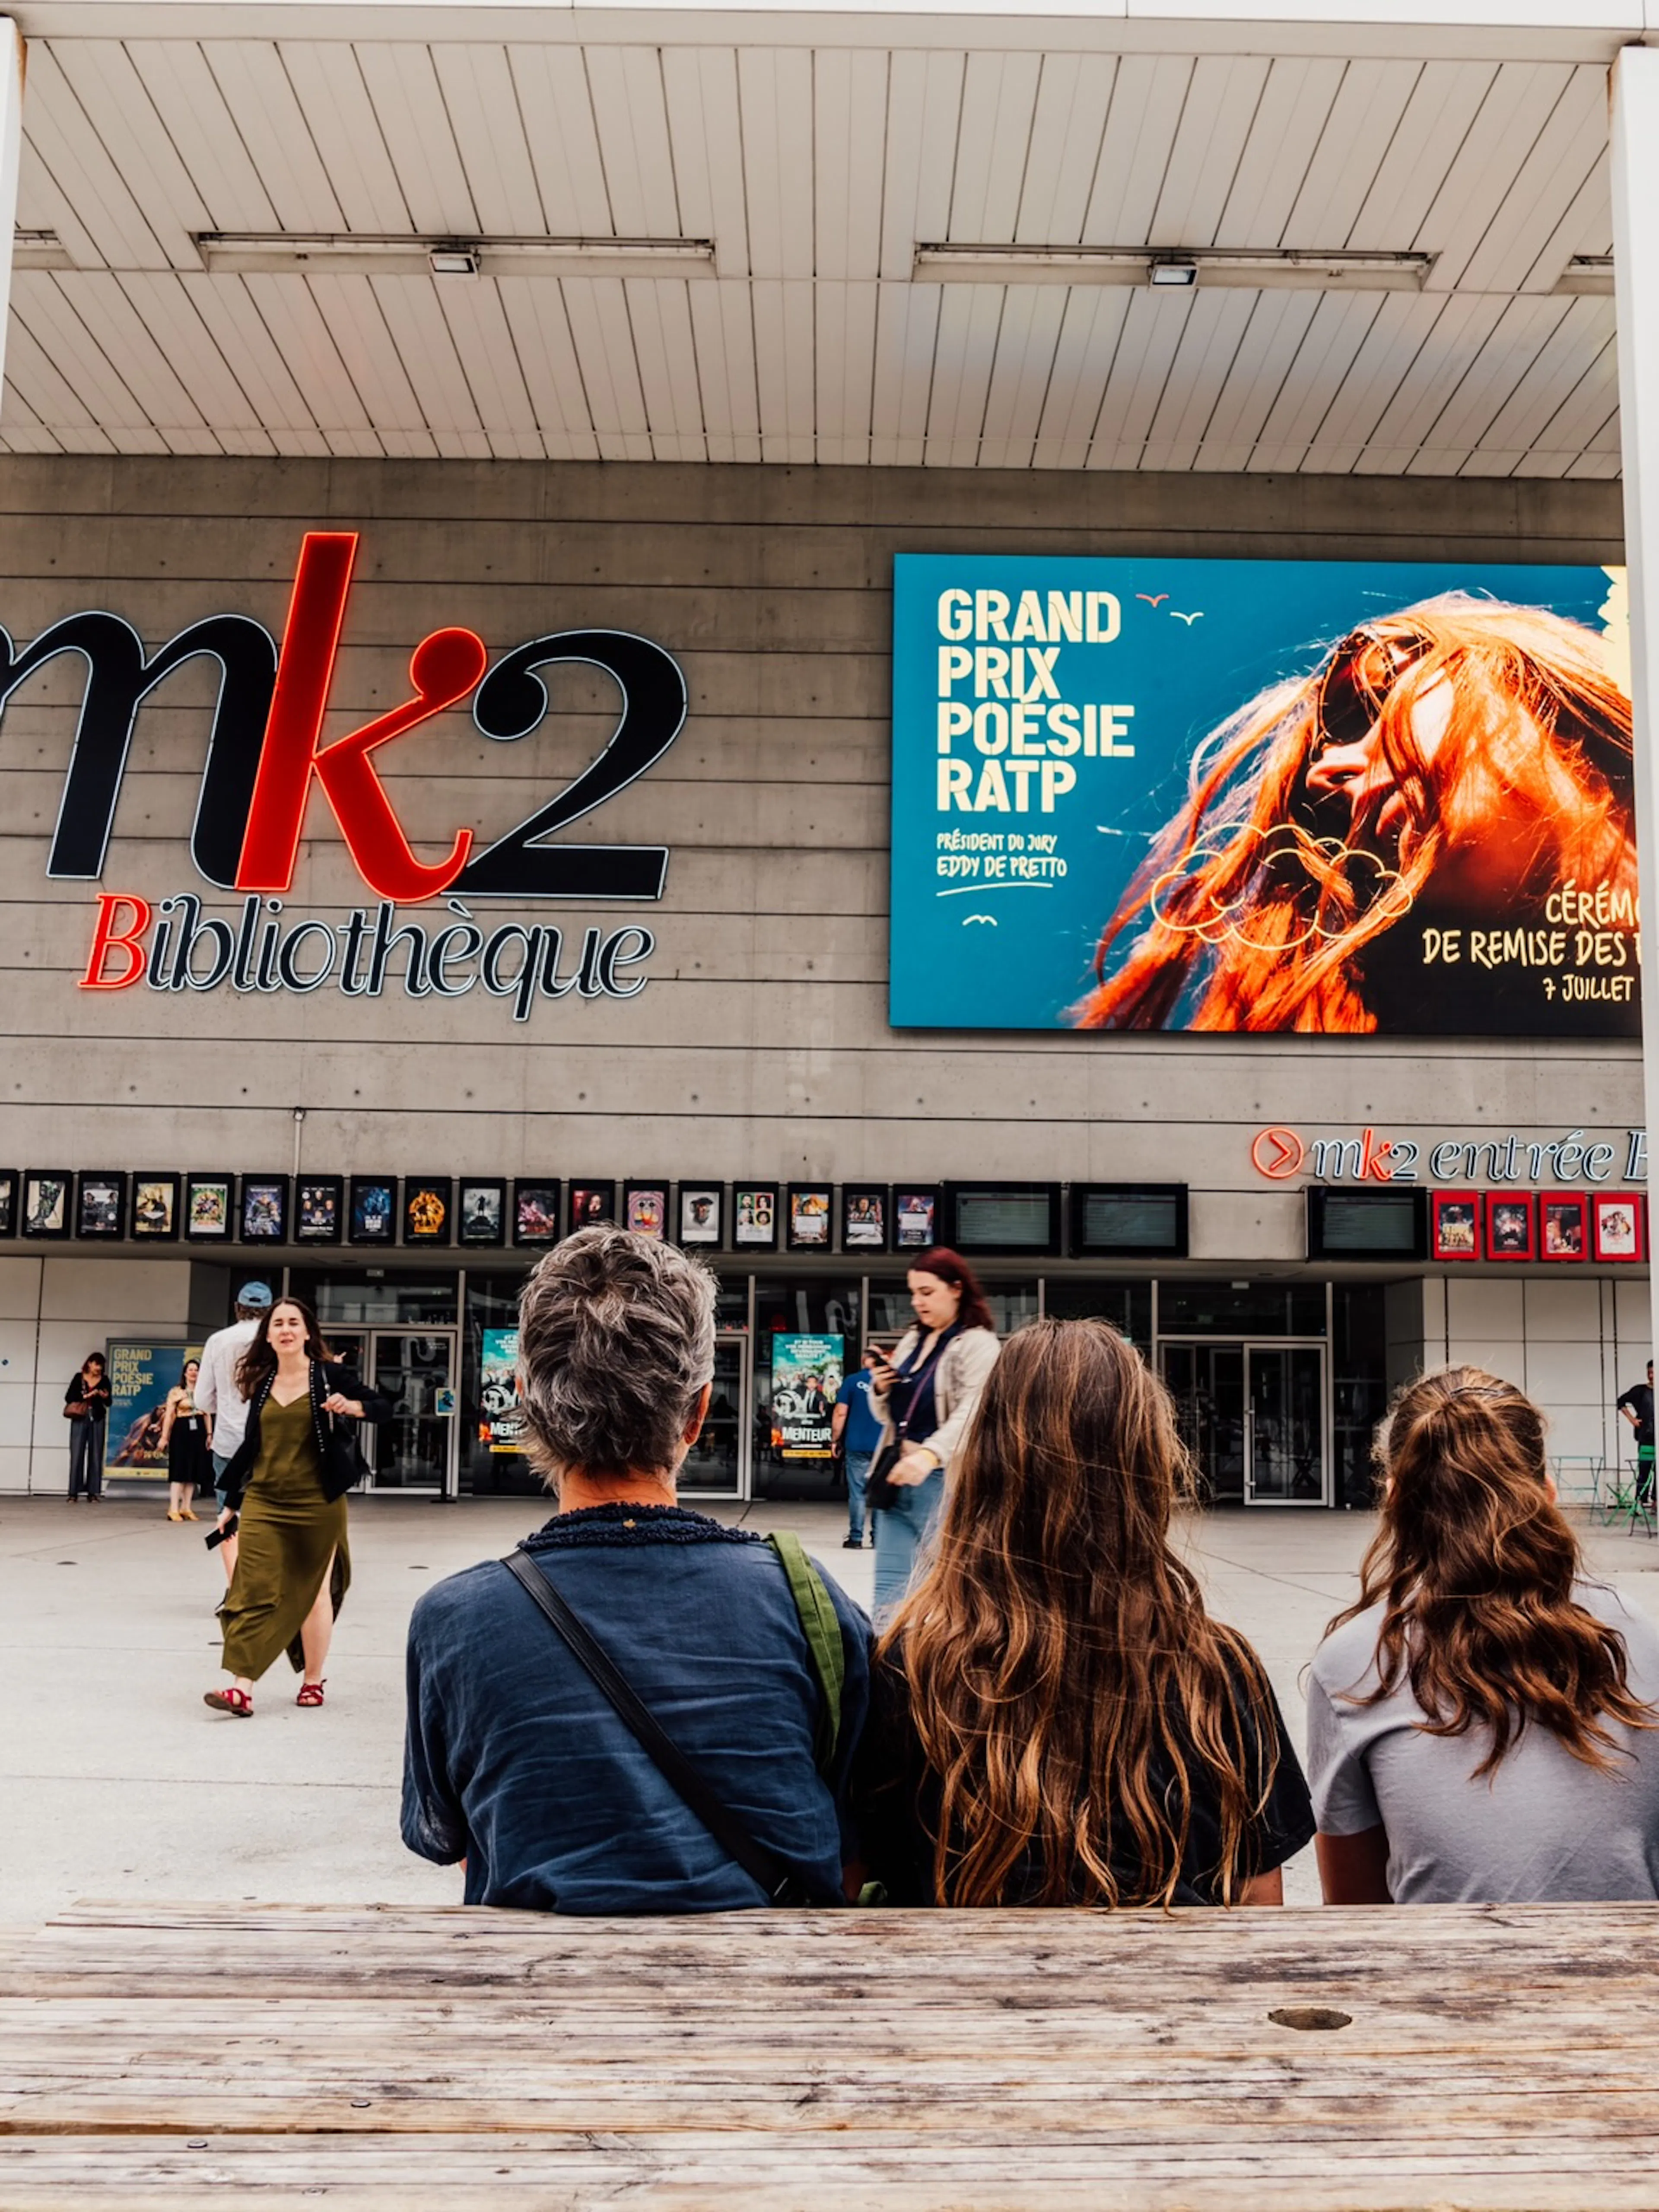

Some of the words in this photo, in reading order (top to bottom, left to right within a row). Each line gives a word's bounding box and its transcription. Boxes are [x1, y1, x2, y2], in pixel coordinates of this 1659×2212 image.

[938, 588, 1121, 643] GRAND
[938, 646, 1061, 699] PRIX
[0, 531, 687, 902] mk2
[937, 692, 1135, 757] POÉSIE
[937, 759, 1077, 813] RATP
[936, 828, 1005, 852] PRÉSIDENT
[1007, 833, 1025, 852] DU
[1027, 834, 1058, 854] JURY
[936, 855, 980, 878] EDDY
[984, 855, 1007, 878] DE
[1009, 855, 1068, 879] PRETTO
[78, 892, 655, 1023] Bibliothèque
[1422, 927, 1462, 965] DE
[1470, 927, 1567, 969] REMISE
[1574, 930, 1627, 967] DES
[1542, 977, 1556, 1001] 7
[1561, 974, 1635, 1001] JUILLET
[1311, 1128, 1419, 1181] mk2
[1430, 1128, 1615, 1181] entrée
[113, 1360, 140, 1373] PRIX
[114, 1348, 152, 1361] GRAND
[111, 1384, 142, 1396] RATP
[782, 1427, 832, 1442] MENTEUR
